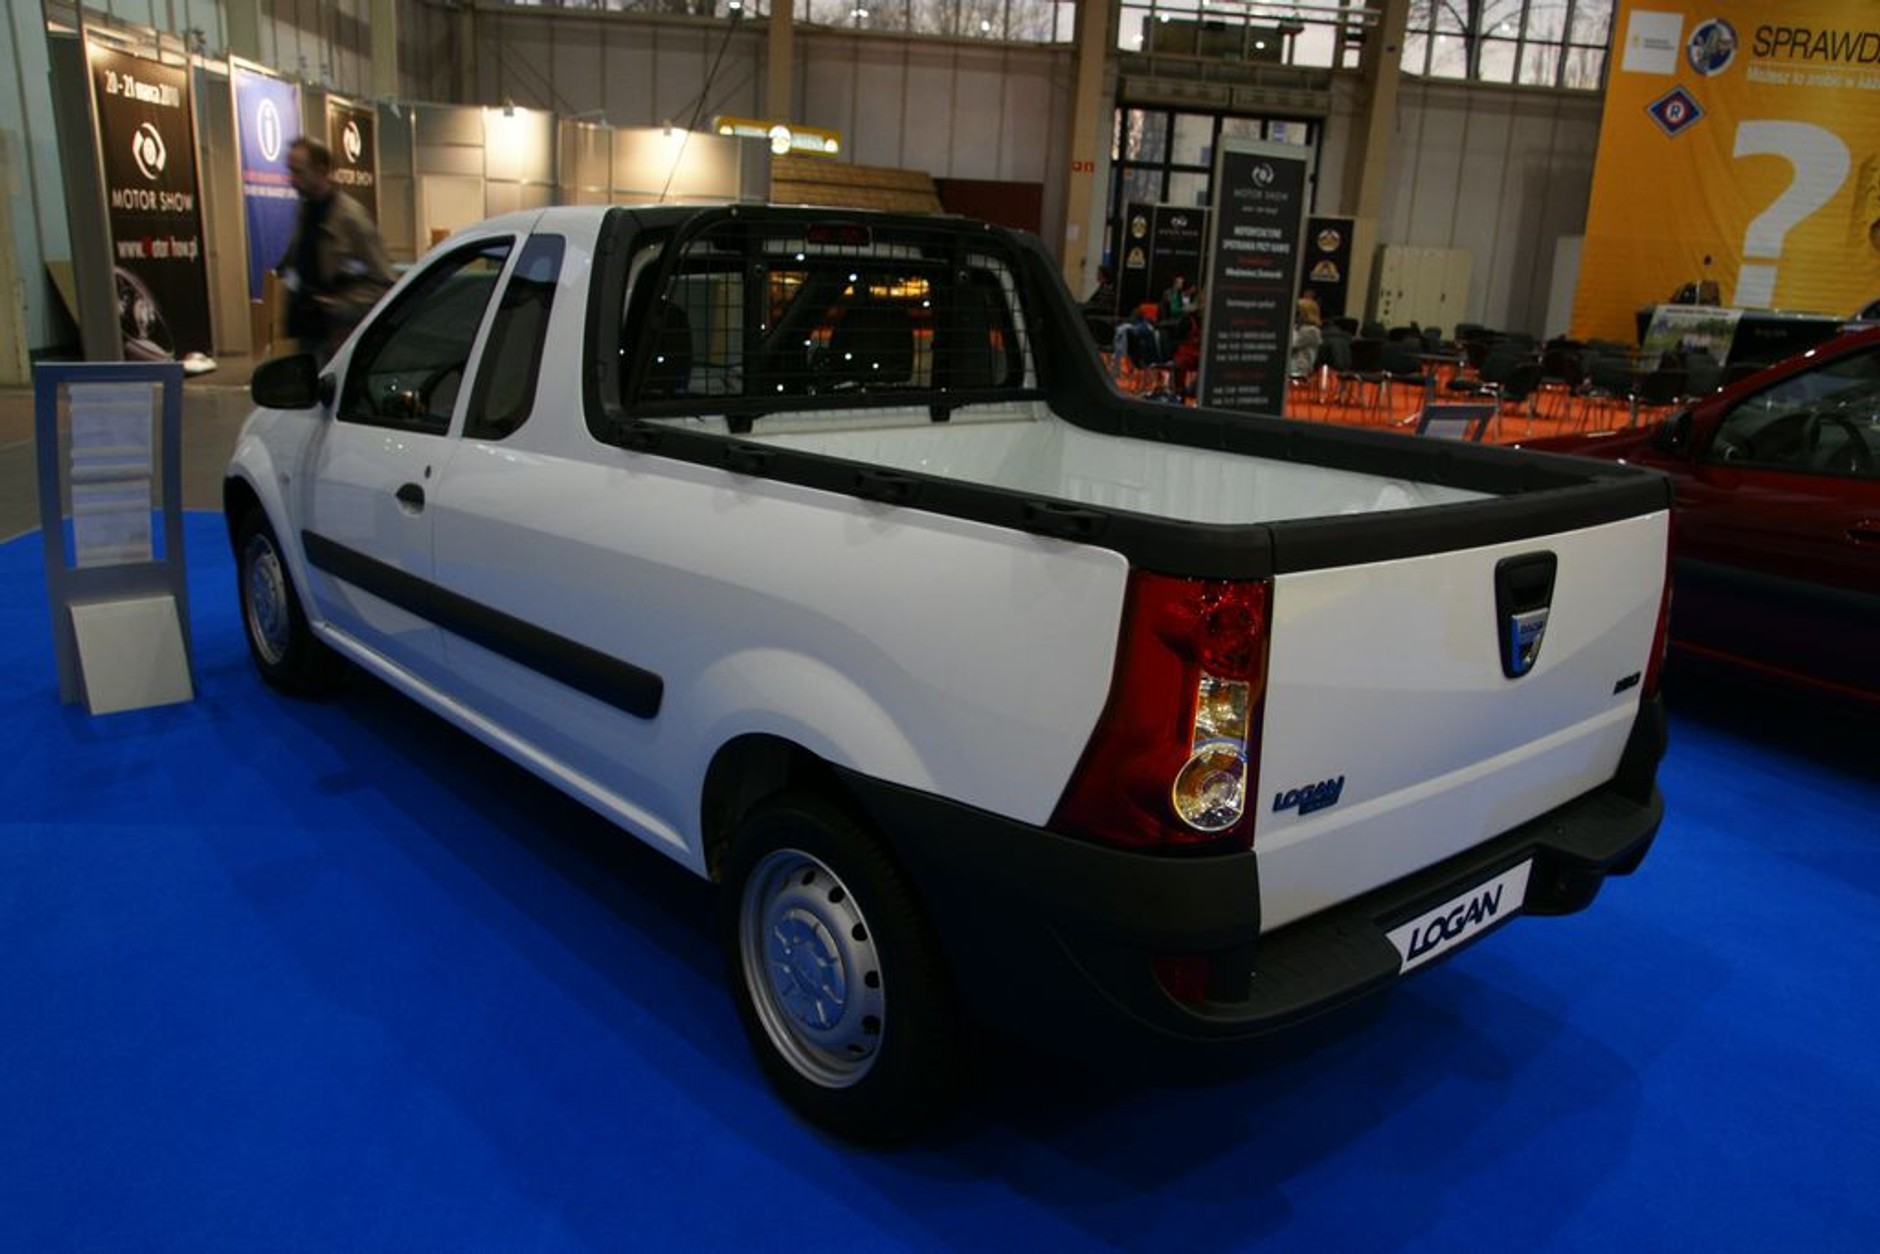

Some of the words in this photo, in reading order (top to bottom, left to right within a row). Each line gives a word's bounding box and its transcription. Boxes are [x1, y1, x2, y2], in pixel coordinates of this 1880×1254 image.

[1753, 25, 1880, 63] SPRAWD
[112, 187, 157, 210] MOTOR
[160, 190, 193, 212] SHOW
[1271, 774, 1345, 812] LOGAN
[1406, 883, 1503, 962] LOGAN
